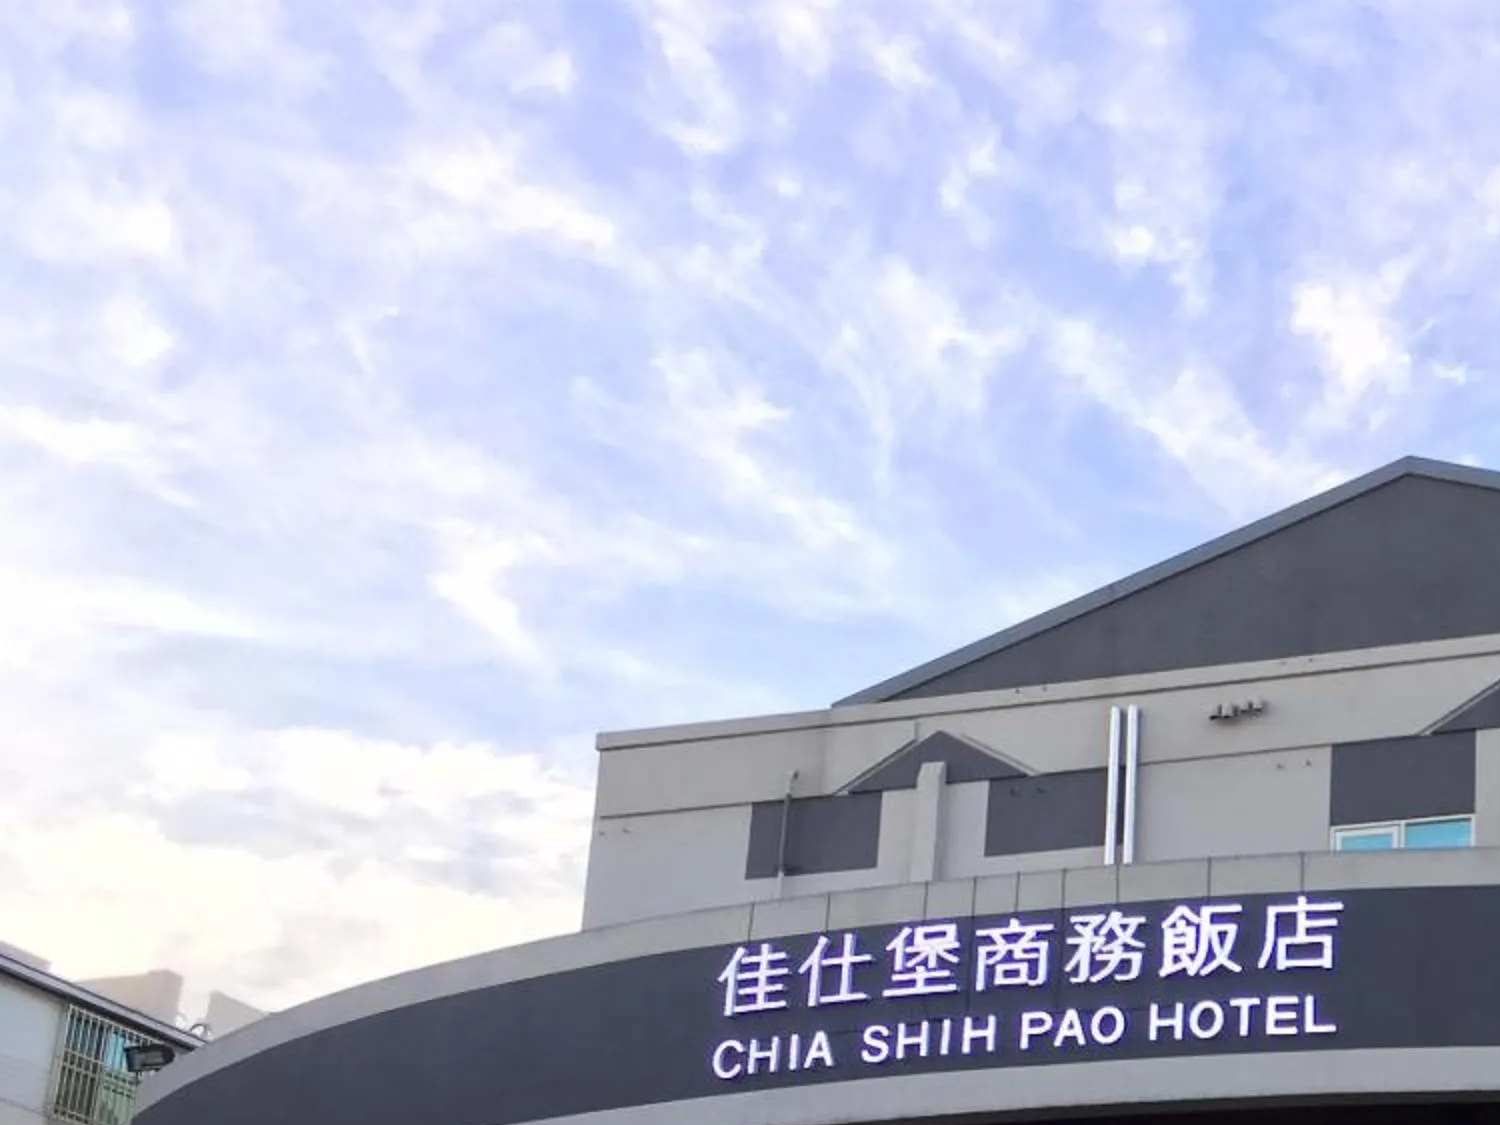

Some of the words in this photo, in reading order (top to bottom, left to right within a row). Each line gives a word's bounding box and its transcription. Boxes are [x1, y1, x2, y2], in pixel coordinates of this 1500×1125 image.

[717, 895, 1343, 1016] 佳仕堡商務飯店
[712, 1030, 832, 1078] CHIA
[861, 1014, 995, 1062] SHIH
[1019, 1006, 1124, 1049] PAO
[1149, 995, 1336, 1040] HOTEL
